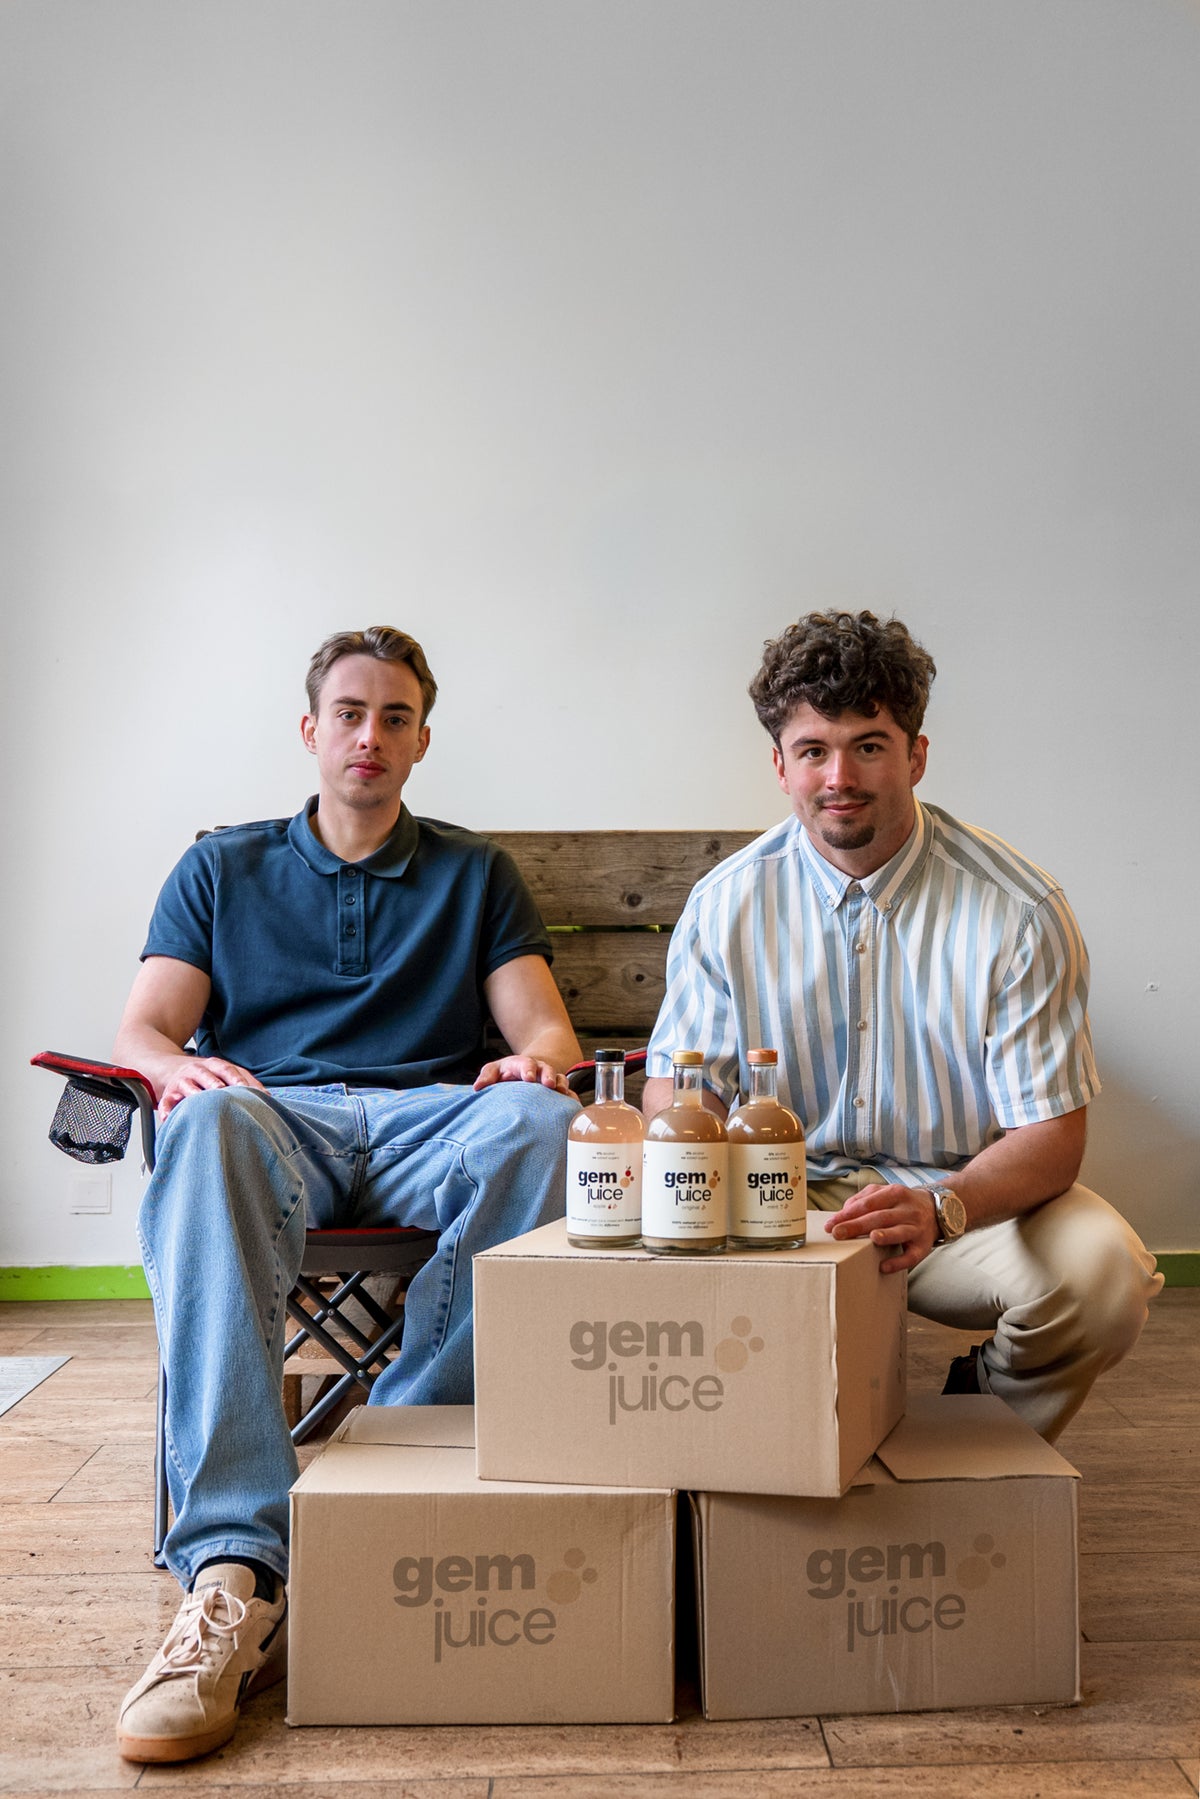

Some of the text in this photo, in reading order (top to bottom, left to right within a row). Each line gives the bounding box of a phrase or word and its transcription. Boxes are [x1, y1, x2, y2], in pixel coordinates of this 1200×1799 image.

[578, 1170, 618, 1187] gem
[587, 1184, 623, 1204] juice
[664, 1171, 707, 1188] gem
[675, 1185, 712, 1206] juice
[747, 1171, 789, 1189] gem
[759, 1186, 794, 1206] juice
[569, 1320, 704, 1371] gem
[607, 1362, 724, 1425] juice
[392, 1553, 536, 1608] gem
[806, 1541, 946, 1600] gem
[433, 1597, 557, 1663] juice
[846, 1585, 967, 1653] juice
